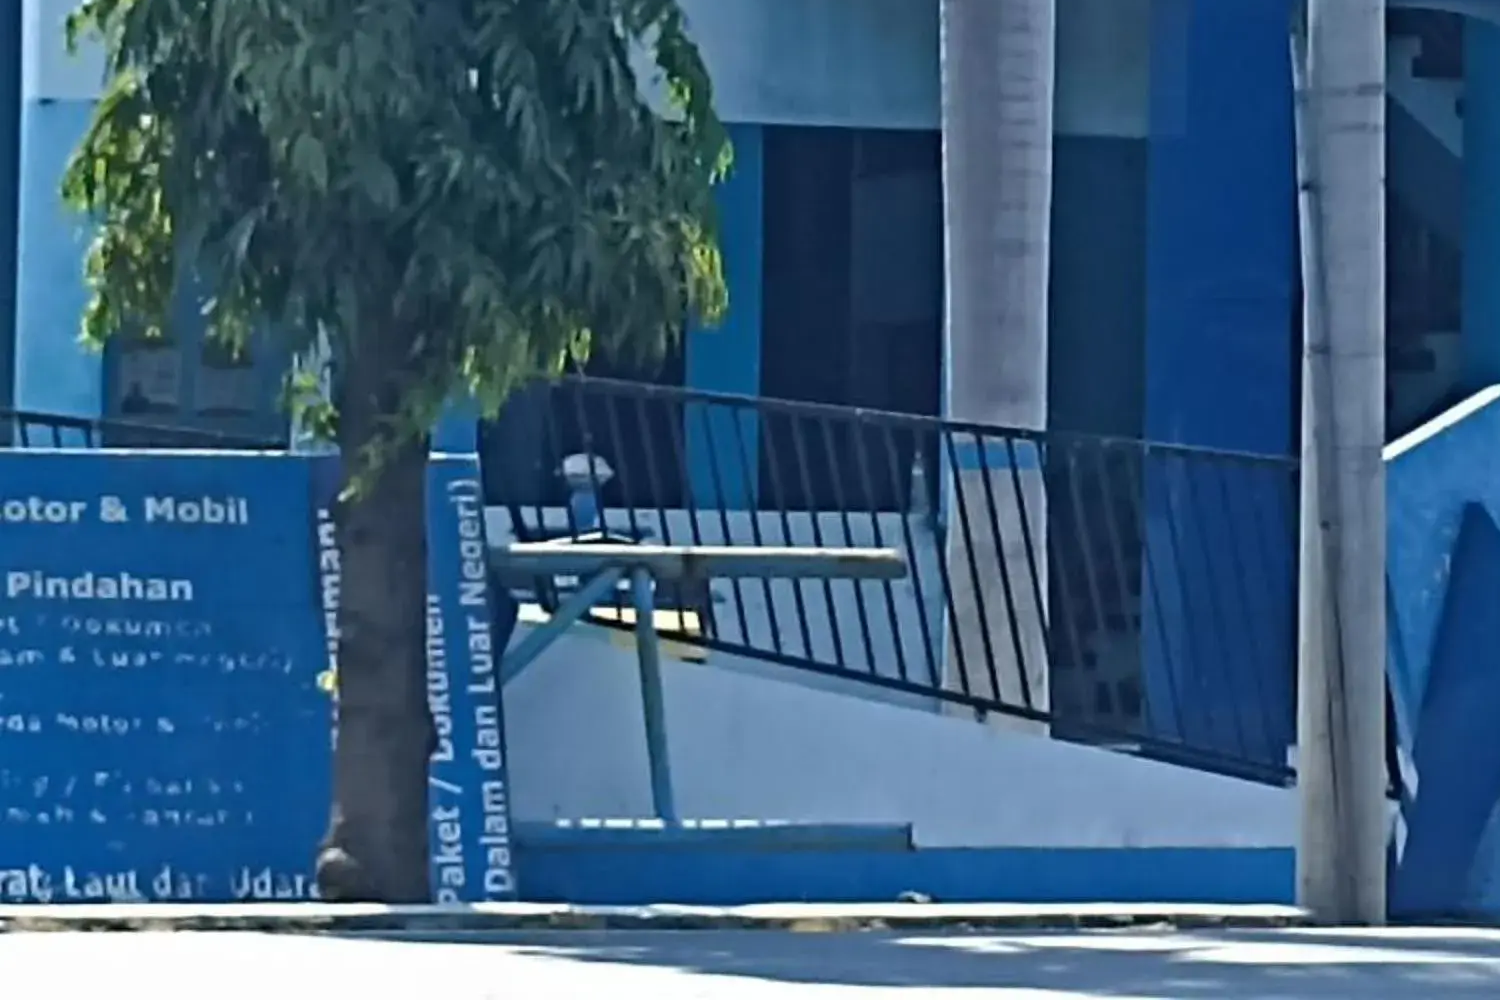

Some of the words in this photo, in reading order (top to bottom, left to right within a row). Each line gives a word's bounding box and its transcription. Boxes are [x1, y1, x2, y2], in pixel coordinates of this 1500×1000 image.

[0, 496, 88, 523] otor
[99, 496, 129, 523] &
[145, 496, 249, 525] Mobil
[447, 479, 487, 606] Negeri)
[6, 571, 194, 601] Pindahan
[465, 615, 496, 693] Luar
[470, 704, 502, 770] dan
[427, 776, 464, 794] /
[479, 780, 516, 902] Dalam
